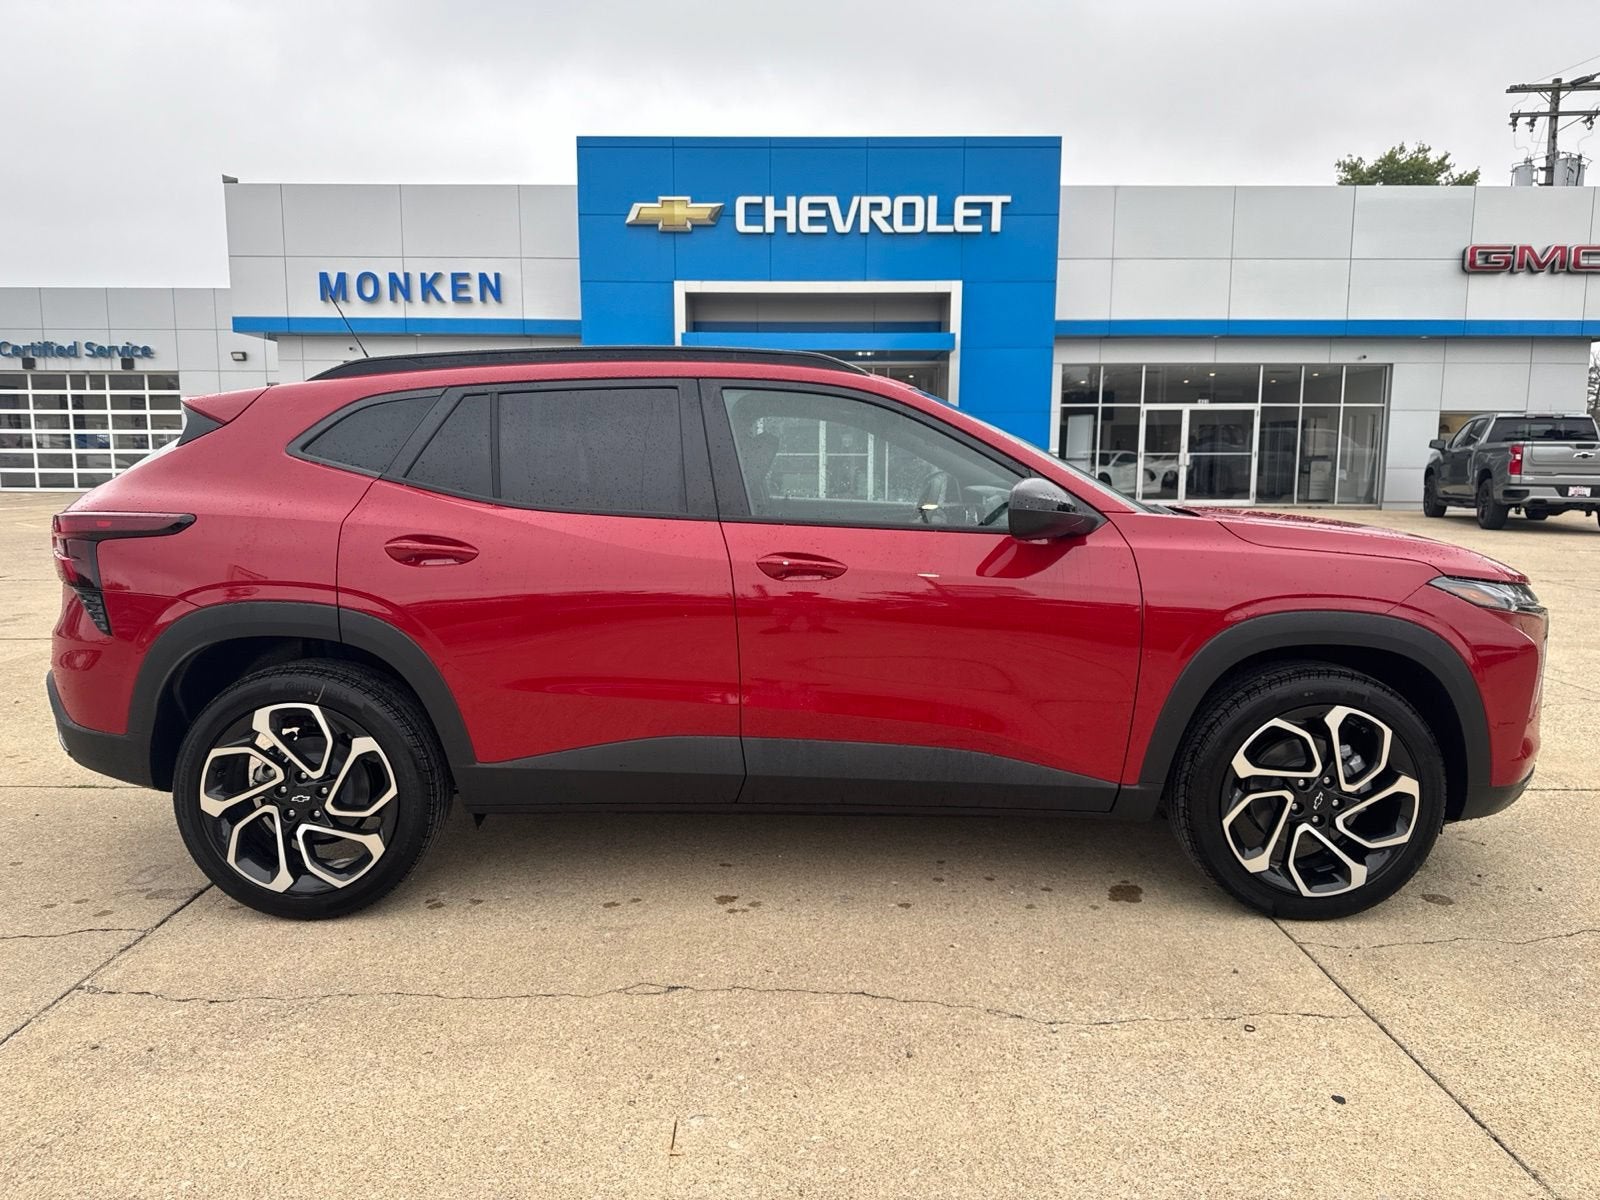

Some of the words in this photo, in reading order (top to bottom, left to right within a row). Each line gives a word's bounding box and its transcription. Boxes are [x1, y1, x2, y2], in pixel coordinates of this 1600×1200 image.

[735, 195, 1011, 233] CHEVROLET
[1464, 244, 1600, 272] GMC
[319, 271, 503, 303] MONKEN
[0, 341, 79, 357] Certified
[84, 341, 153, 358] Service
